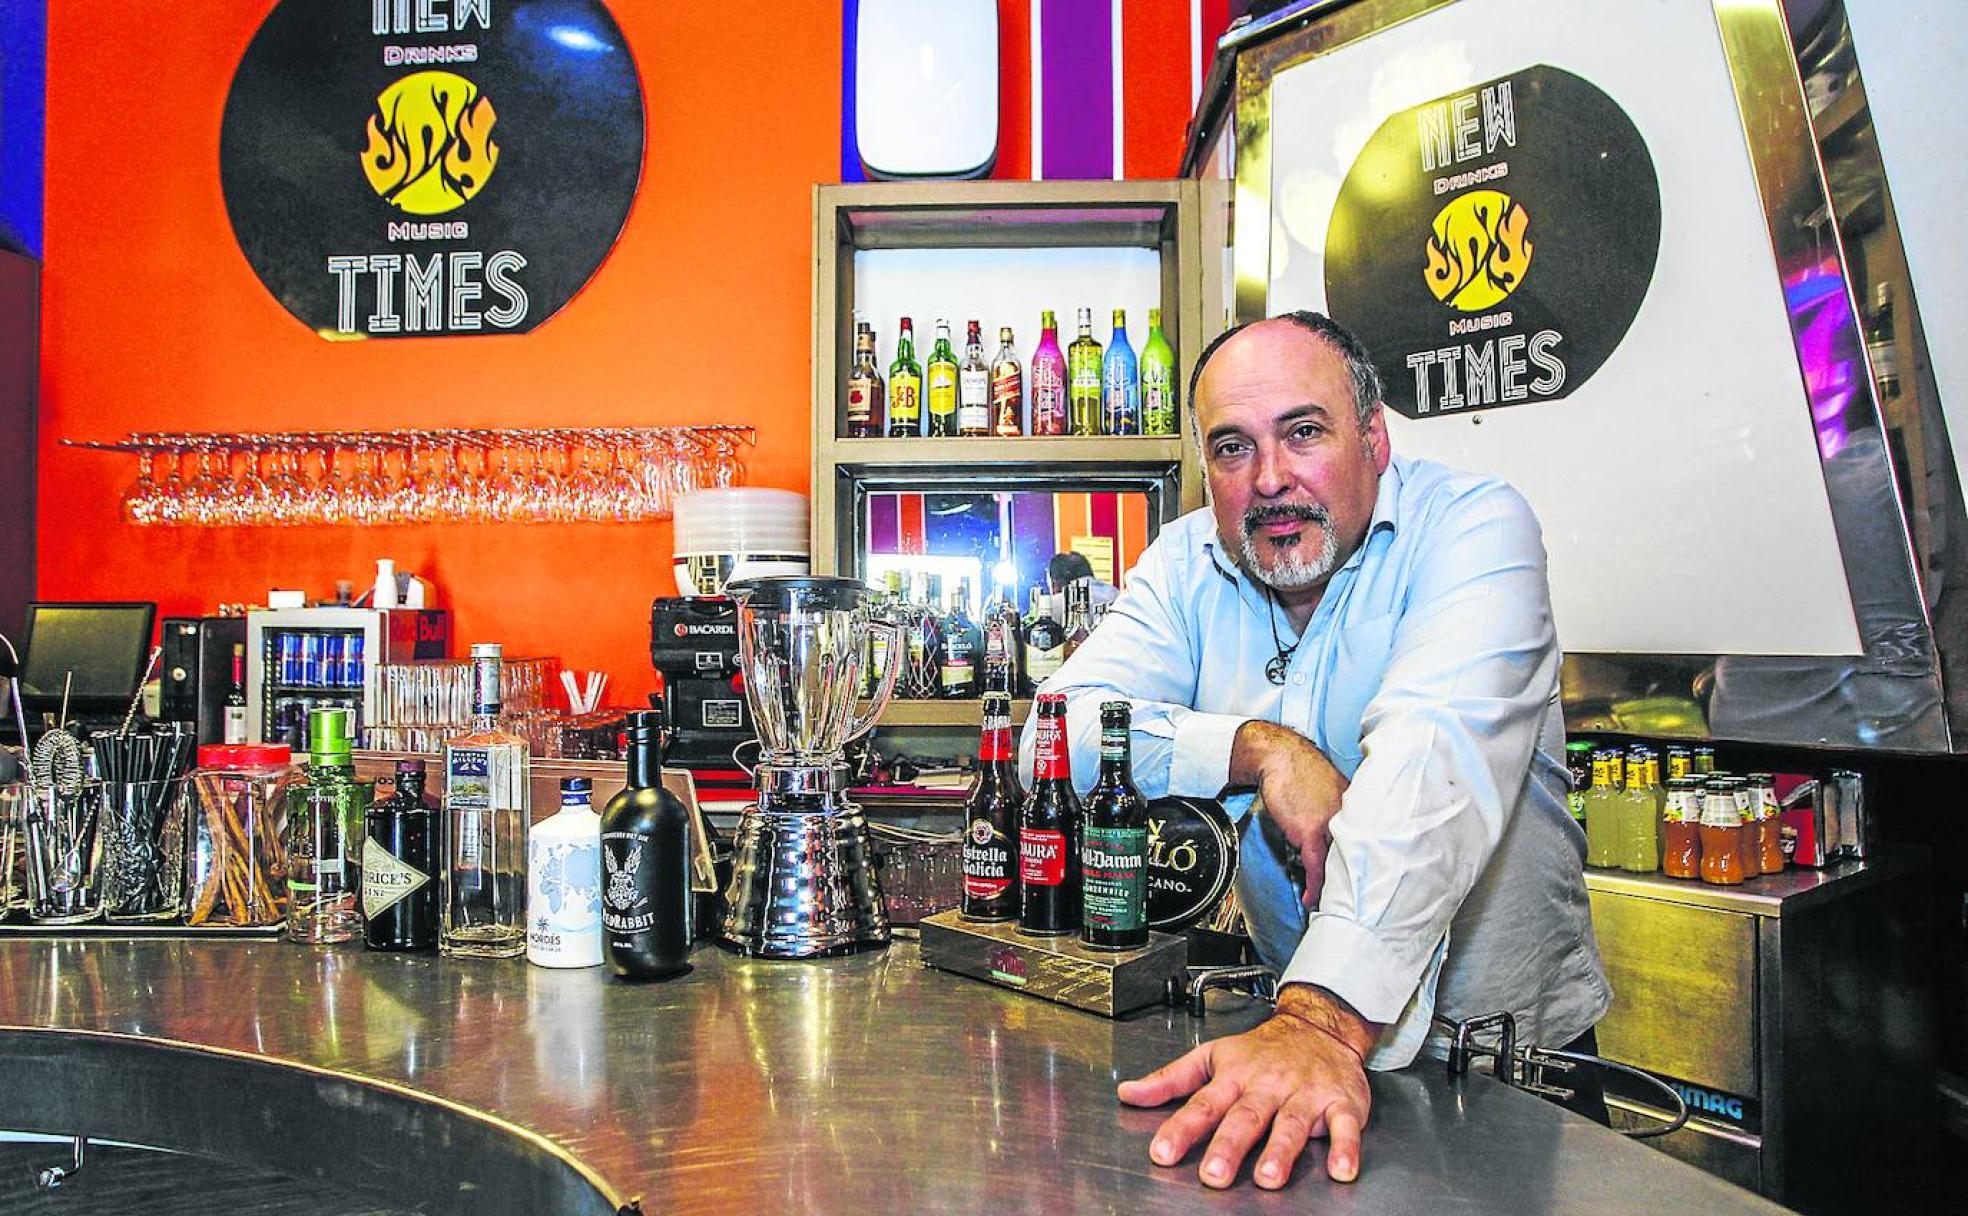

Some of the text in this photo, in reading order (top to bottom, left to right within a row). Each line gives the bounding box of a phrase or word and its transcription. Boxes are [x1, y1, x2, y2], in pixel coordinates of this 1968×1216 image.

[1417, 81, 1517, 172] NEW
[1433, 162, 1508, 195] DRINKS
[388, 222, 468, 241] MUSIC
[328, 251, 528, 333] TIMES
[1449, 312, 1512, 336] MUSIC
[1407, 330, 1566, 414] TIMES
[963, 843, 1008, 862] Estrella
